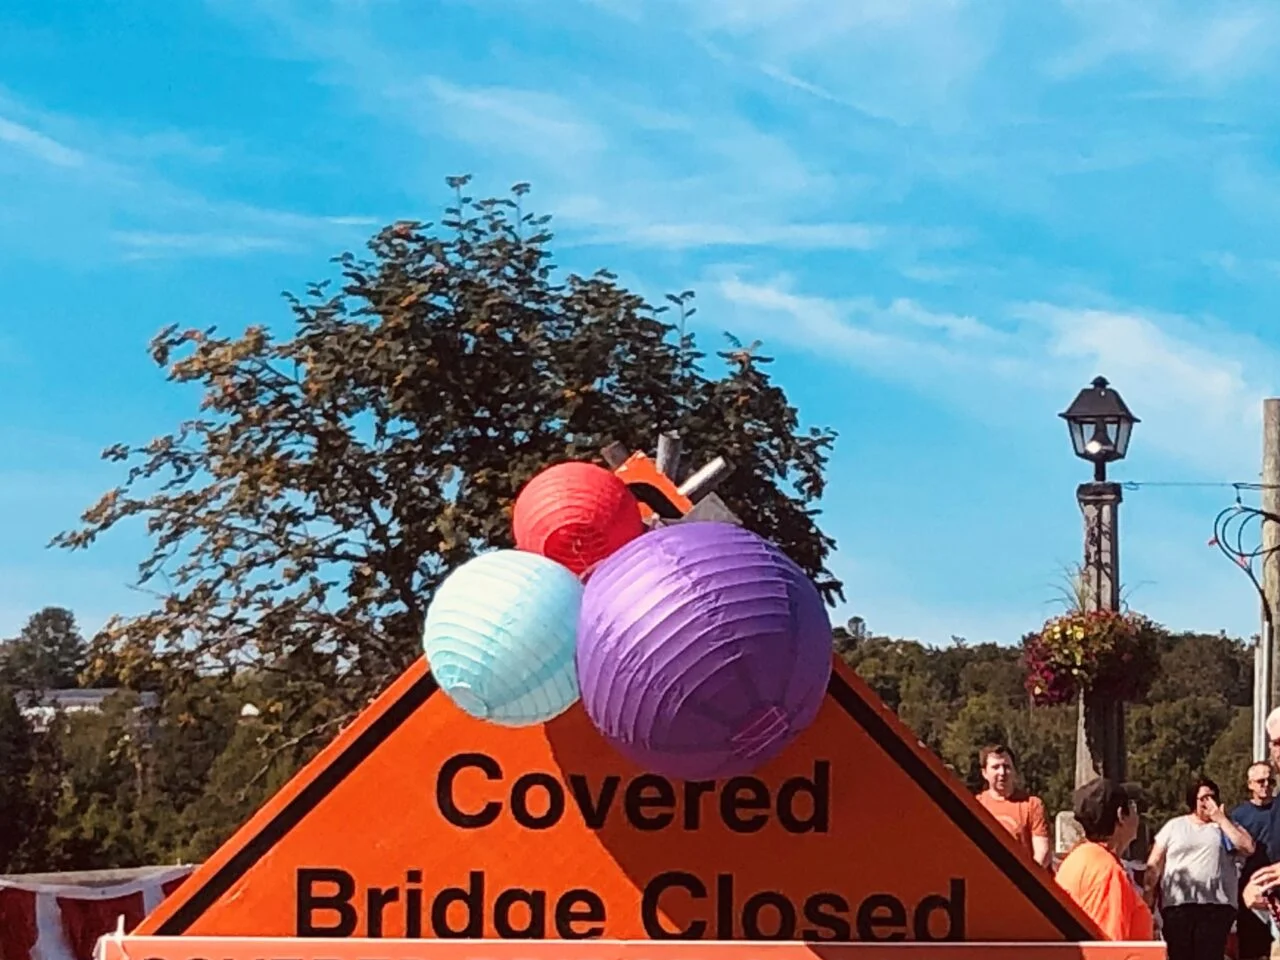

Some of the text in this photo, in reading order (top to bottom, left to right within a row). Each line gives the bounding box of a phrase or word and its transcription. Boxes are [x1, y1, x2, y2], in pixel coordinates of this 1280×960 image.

[435, 752, 831, 834] Covered
[296, 867, 967, 942] Bridge Closed
